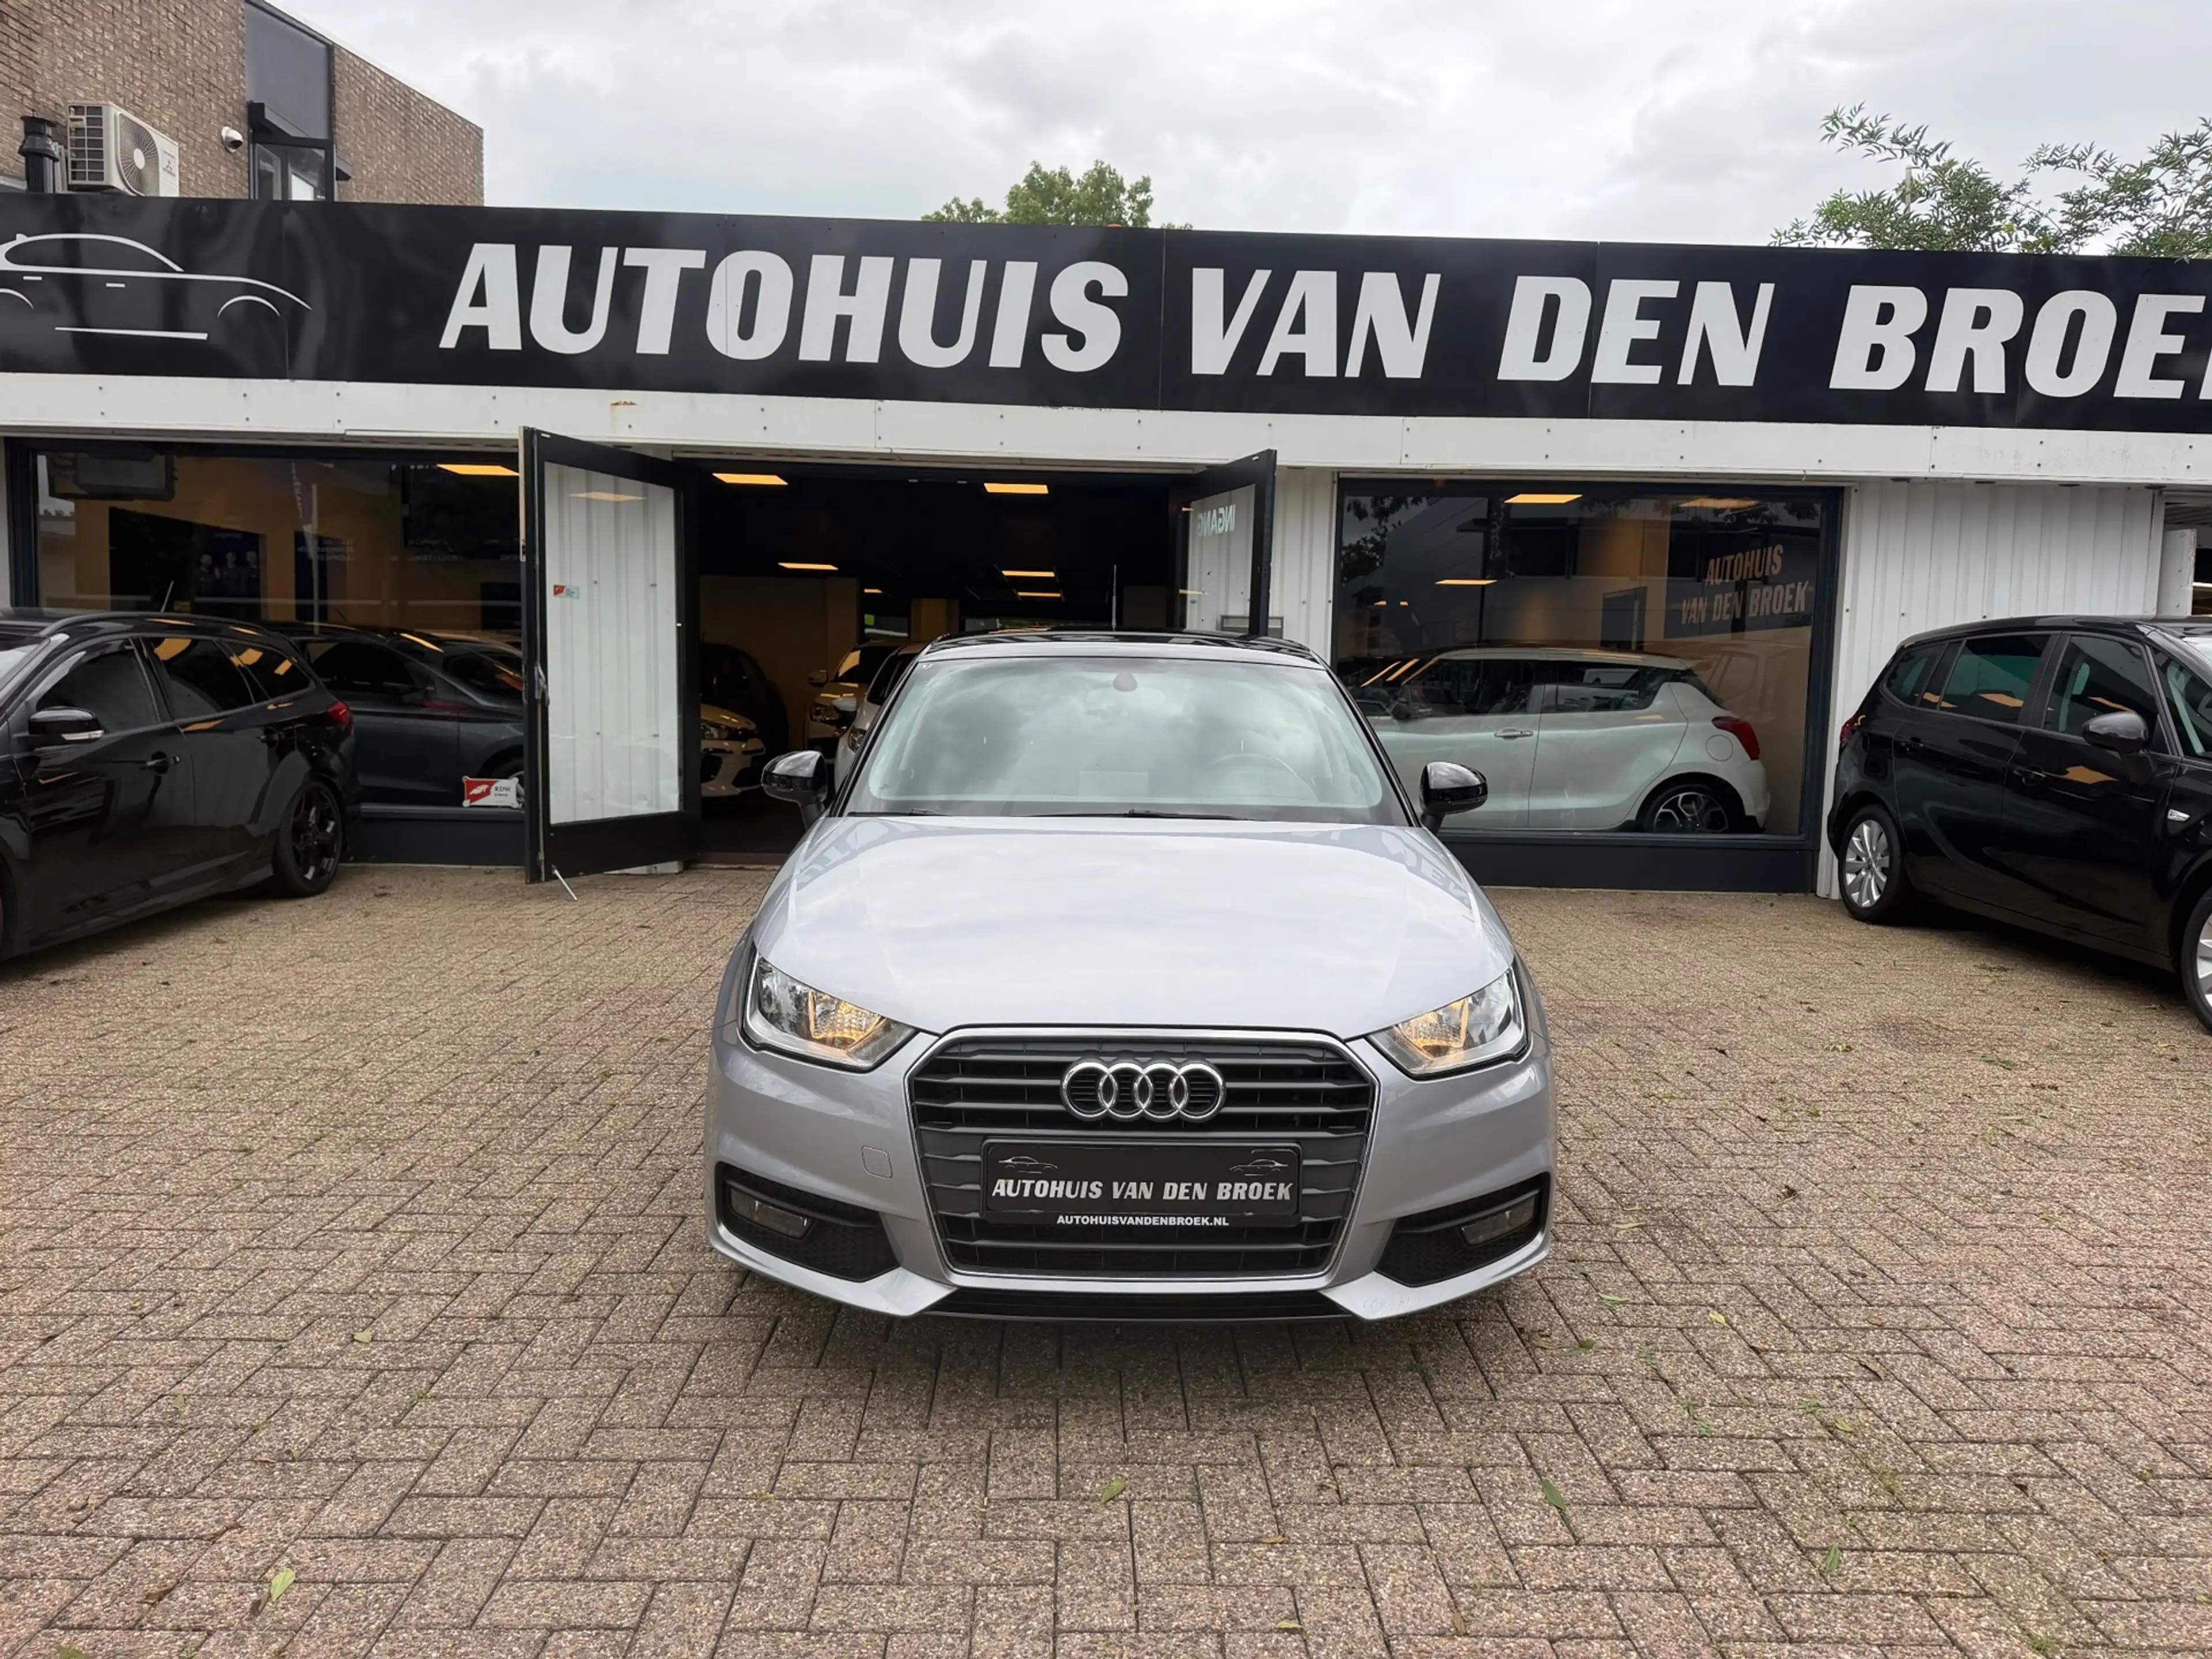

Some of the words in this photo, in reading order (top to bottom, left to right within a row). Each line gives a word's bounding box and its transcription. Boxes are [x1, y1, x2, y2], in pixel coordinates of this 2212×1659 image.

[440, 244, 1127, 372] AUTOHUIS
[1192, 268, 1441, 378] VAN
[1498, 276, 1774, 386] DEN
[1830, 285, 2212, 399] BROE
[1705, 544, 1783, 587] AUTOHUIS
[1681, 596, 1708, 624] VAN
[1711, 590, 1744, 622] DEN
[1748, 581, 1809, 617] BROEK
[992, 1179, 1103, 1199] AUTOHUIS
[1113, 1182, 1153, 1199] VAN
[1163, 1183, 1207, 1200] DEN
[1217, 1182, 1293, 1200] BROEK
[1057, 1215, 1229, 1225] AUTOHUISVANDENBROEK.NL
